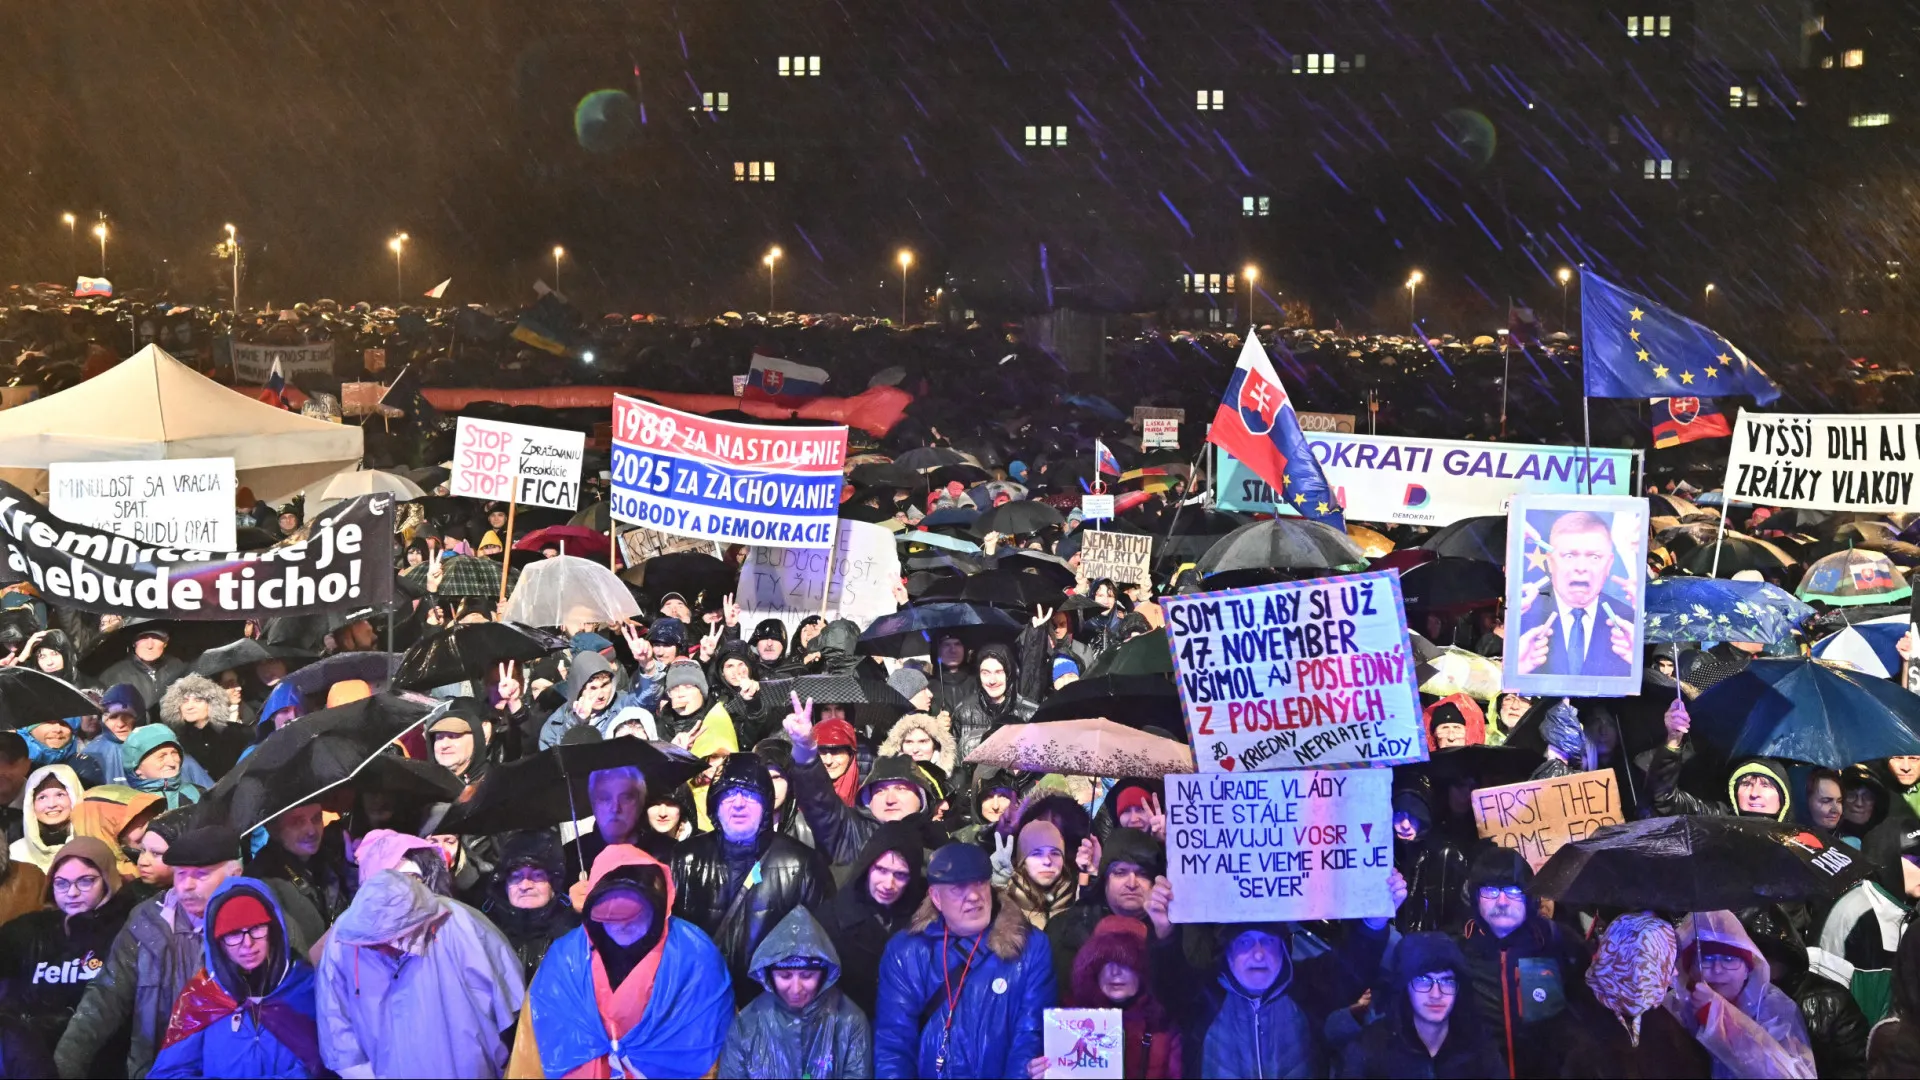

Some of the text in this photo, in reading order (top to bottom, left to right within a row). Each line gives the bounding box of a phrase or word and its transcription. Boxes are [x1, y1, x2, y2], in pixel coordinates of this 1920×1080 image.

[462, 424, 513, 452] STOP
[617, 406, 841, 465] 1989 ZA NASTOLENIE
[1299, 415, 1337, 431] OBODA
[1747, 418, 1811, 457] VYŠŠÍ
[1827, 425, 1867, 461] DLH
[1880, 424, 1906, 461] AJ
[461, 449, 510, 473] STOP
[1309, 441, 1616, 486] OKRATI GALANTA
[143, 476, 165, 497] SA
[173, 473, 220, 492] VRACIA
[458, 470, 509, 496] STOP
[521, 478, 578, 508] FICA!
[612, 450, 836, 509] 2025 ZA ZACHOVANIE
[1735, 460, 1914, 505] ZRÁŽKY VLAKOV
[134, 517, 178, 543] BUDÚ
[611, 493, 690, 530] SLOBODY
[707, 514, 831, 543] DEMOKRACIE
[1392, 512, 1436, 521] DEMOKRATI
[315, 517, 363, 570] je
[1133, 536, 1151, 554] MI
[1082, 561, 1113, 579] TAKOM
[1135, 553, 1146, 566] V
[216, 559, 362, 610] ticho!
[753, 572, 856, 606] TY ŽIJEŠ
[1170, 581, 1377, 637] SOM TU, ABY SI UŽ
[1181, 619, 1359, 670] 17. NOVEMBER
[1183, 643, 1405, 703] VŠIMOL AJ POSLEDNÝ
[1196, 688, 1395, 735] Z POSLEDNÝCH.
[1293, 720, 1386, 765] NEPRIATEĽ
[1355, 736, 1412, 759] VLÁDY
[1178, 771, 1347, 801] NA ÚRADE VLÁDY
[1171, 799, 1298, 825] EŠTE STÁLE
[1479, 777, 1611, 830] FIRST THEY
[1176, 822, 1373, 849] OSLAVUJÚ VOSR !
[1181, 846, 1388, 875] MY ALE VIEME KDE JE
[1811, 846, 1852, 876] PARIS
[1233, 872, 1309, 899] "SEVER"
